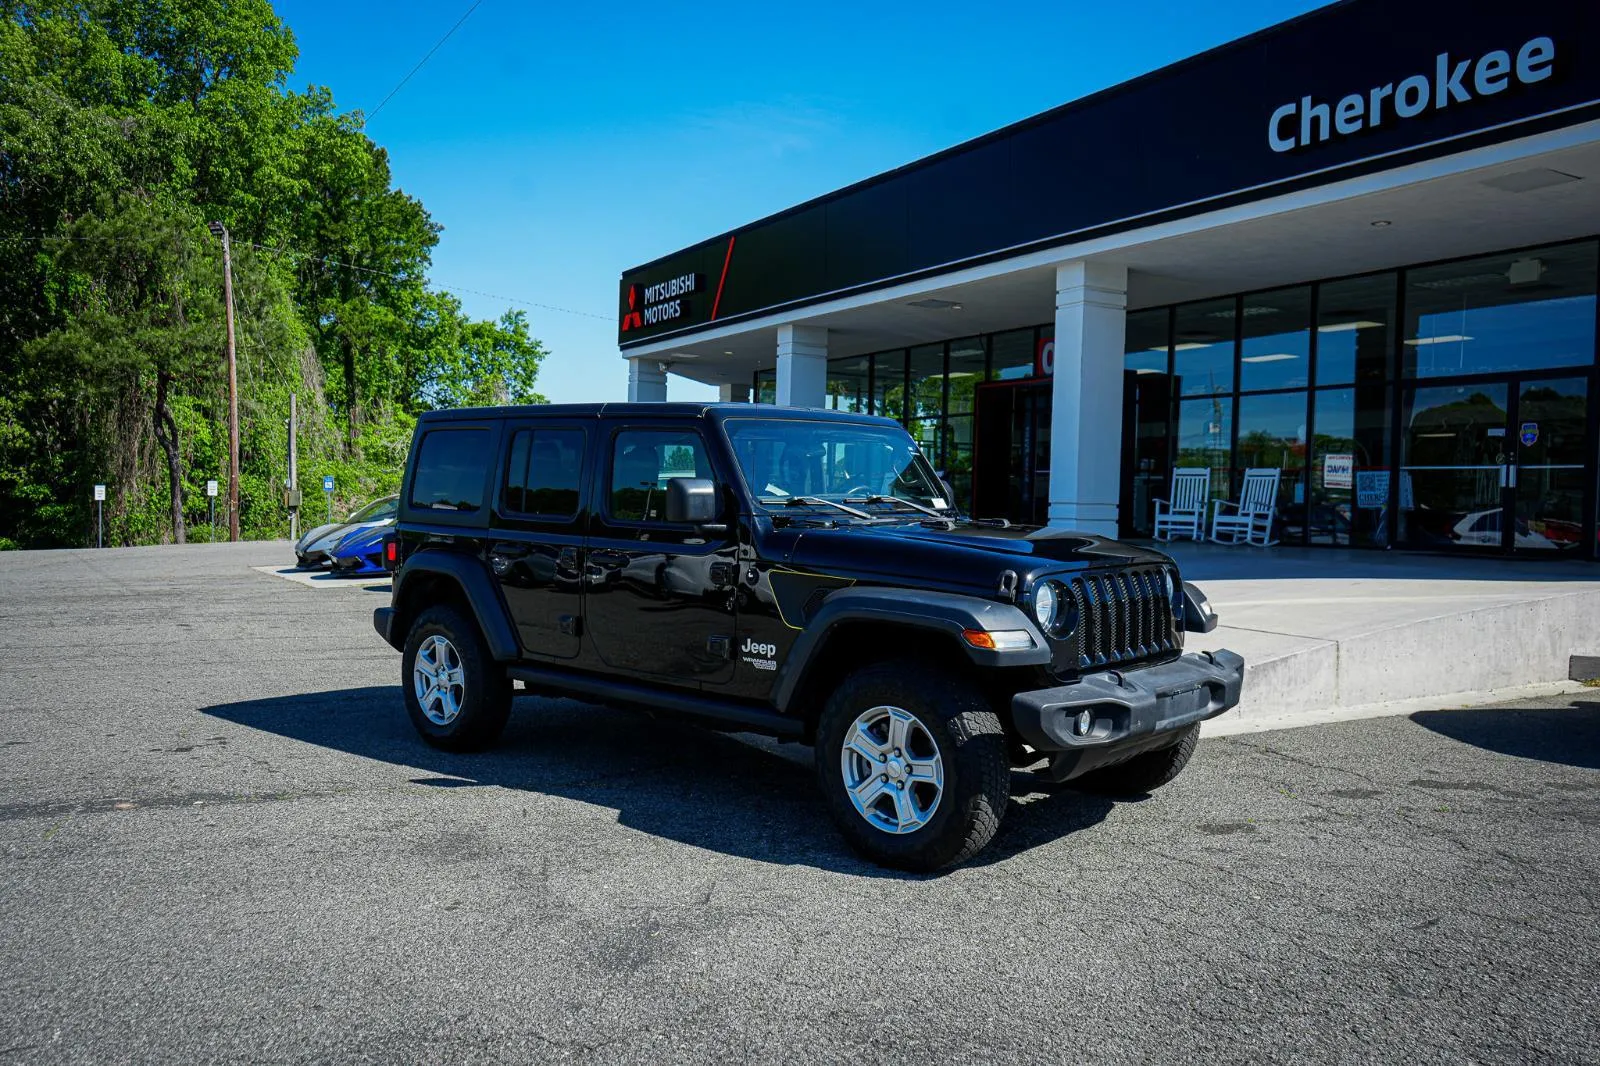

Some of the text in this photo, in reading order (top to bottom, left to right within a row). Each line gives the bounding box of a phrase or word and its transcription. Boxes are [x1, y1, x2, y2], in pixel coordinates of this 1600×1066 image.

[1268, 36, 1555, 153] Cherokee
[644, 272, 695, 305] MITSUBISHI
[644, 299, 681, 326] MOTORS
[741, 638, 776, 658] Jeep
